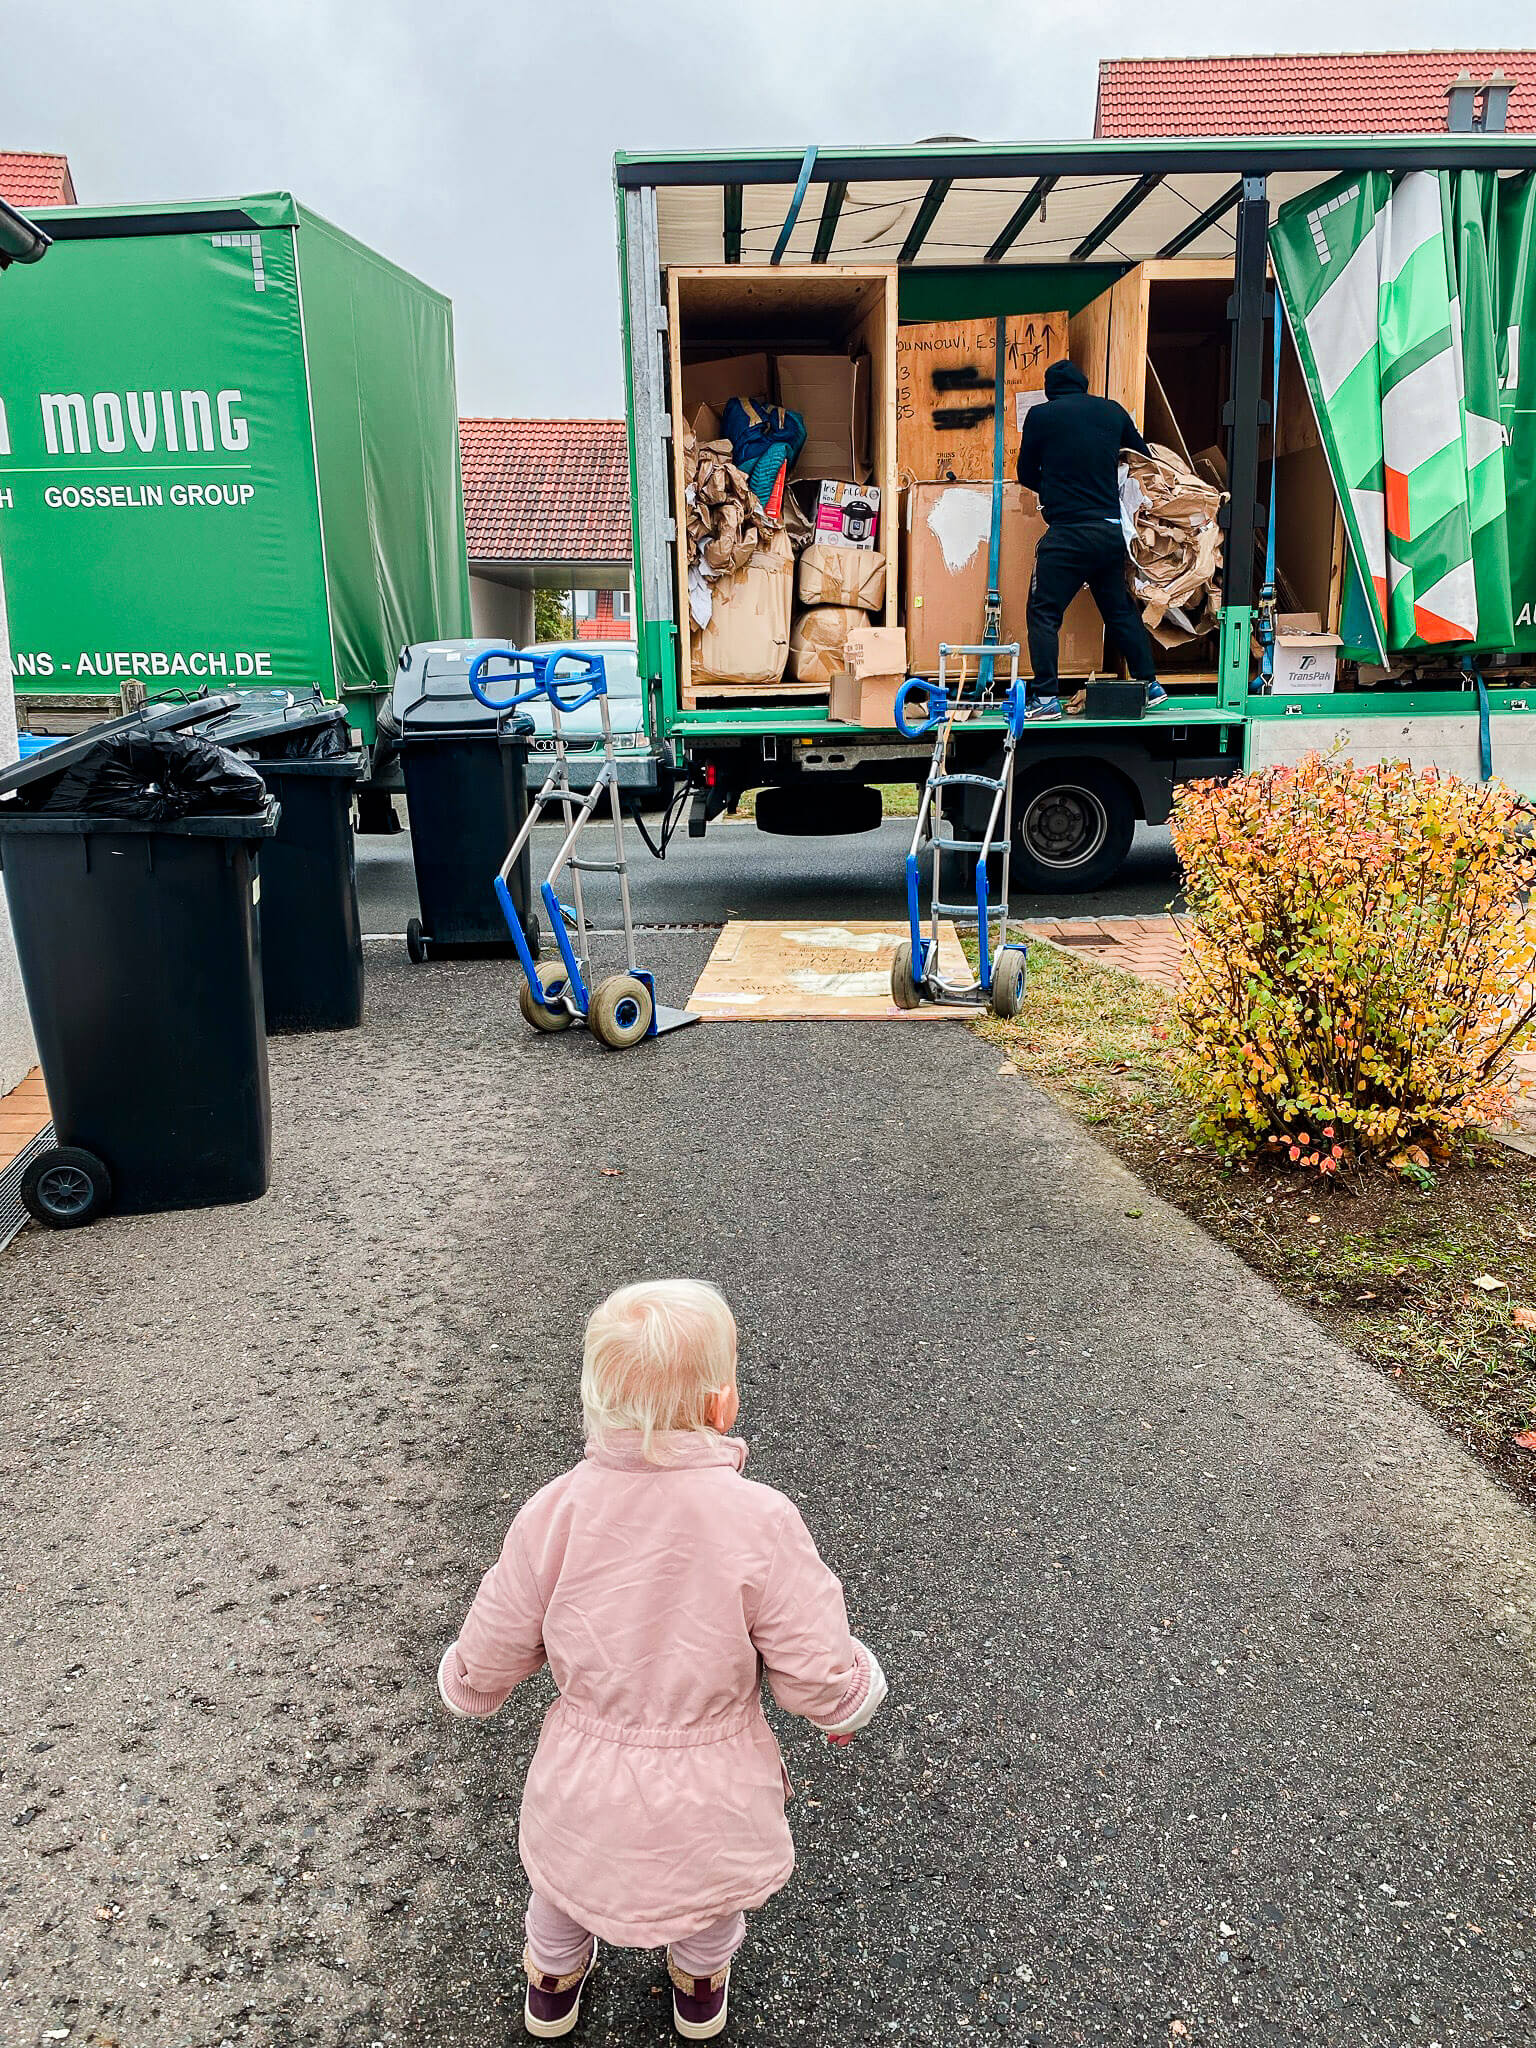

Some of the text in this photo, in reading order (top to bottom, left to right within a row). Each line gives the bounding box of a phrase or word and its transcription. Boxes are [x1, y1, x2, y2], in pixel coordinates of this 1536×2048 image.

[40, 389, 250, 454] MOVING
[44, 484, 255, 508] GOSSELIN GROUP
[76, 652, 273, 677] AUERBACH.DE
